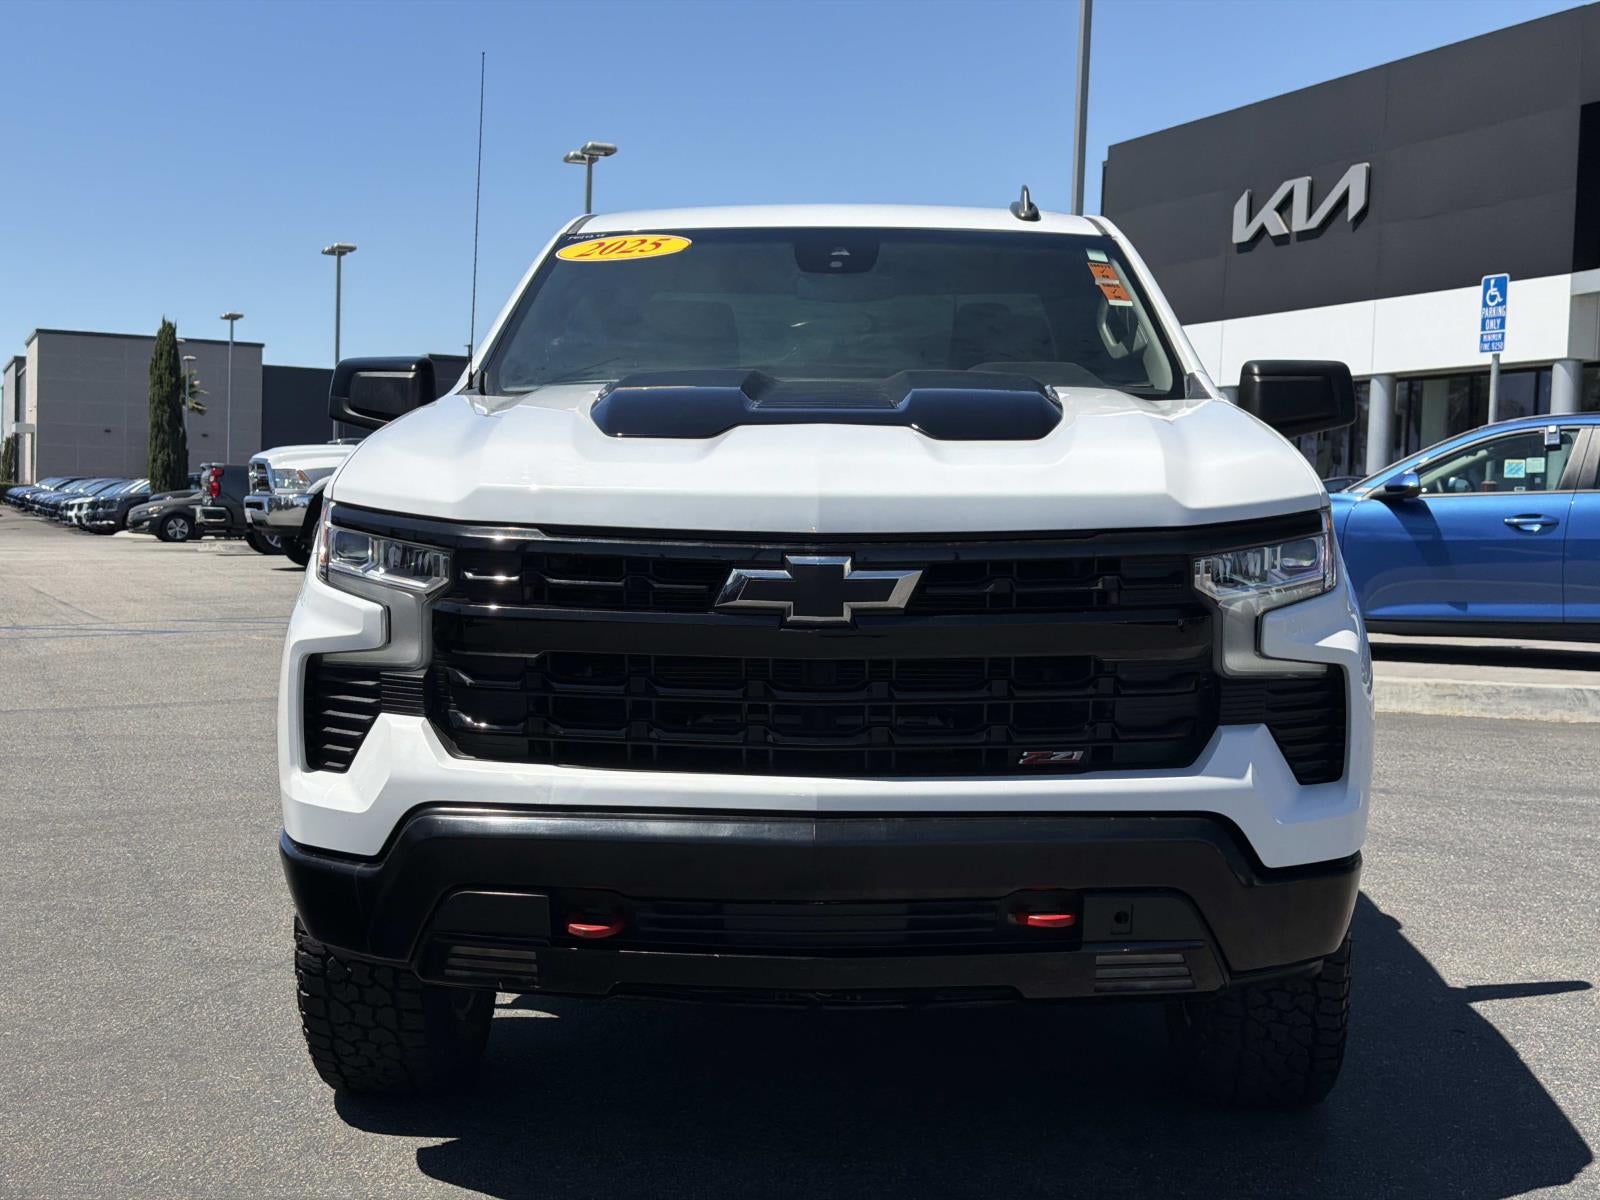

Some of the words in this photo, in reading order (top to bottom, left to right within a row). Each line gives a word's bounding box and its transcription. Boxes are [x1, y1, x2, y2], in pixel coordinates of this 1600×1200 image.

[574, 238, 670, 258] 2025
[1481, 305, 1506, 318] PARKING
[1485, 318, 1501, 330] ONLY
[1482, 333, 1502, 342] MINIMUM
[1018, 750, 1084, 765] Z71
